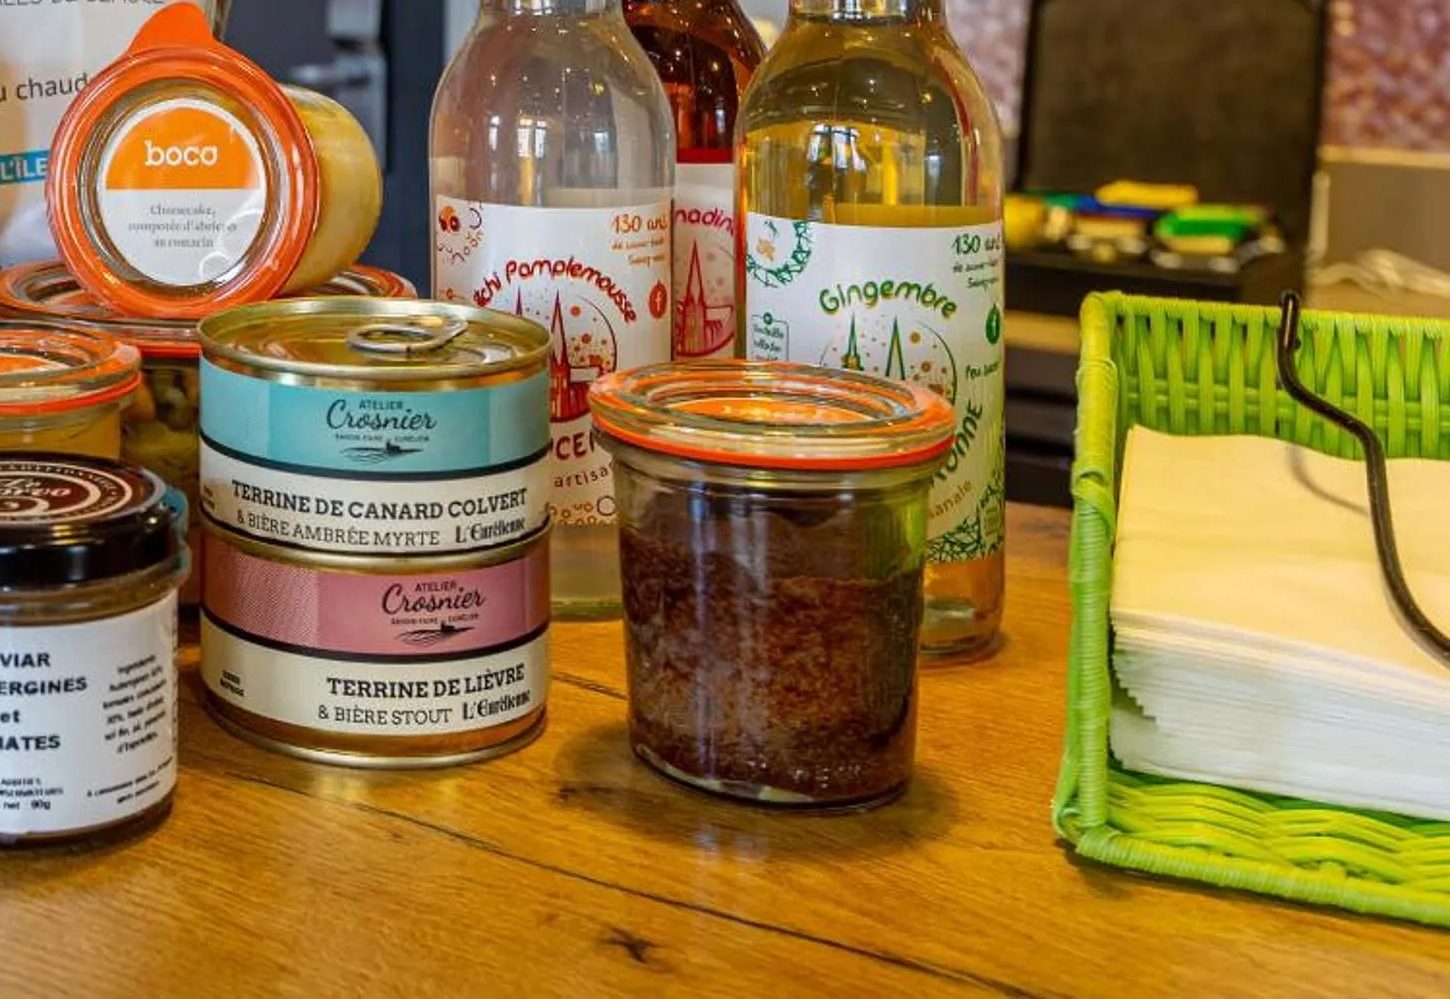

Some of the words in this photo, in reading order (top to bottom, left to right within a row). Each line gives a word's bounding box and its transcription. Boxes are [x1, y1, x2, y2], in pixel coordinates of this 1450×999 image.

[144, 138, 218, 166] boco
[612, 214, 641, 234] 130
[951, 233, 981, 254] 130
[506, 256, 637, 325] Pamplemousse
[818, 278, 959, 318] Gingembre
[326, 398, 437, 431] Crosnier
[359, 399, 403, 410] ATELIER
[232, 480, 311, 514] TERRINE
[314, 496, 344, 518] DE
[348, 500, 442, 523] CANARD
[448, 487, 528, 518] COLVERT
[237, 510, 247, 525] &
[248, 511, 290, 538] BIÈRE
[291, 522, 370, 547] AMBRÉE
[374, 530, 440, 547] MYRTE
[382, 582, 486, 616] Crosnier
[414, 580, 458, 592] ATELIER
[327, 677, 429, 700] TERRINE
[433, 679, 461, 697] DE
[465, 663, 525, 695] LIÈVRE
[0, 710, 21, 723] et
[318, 705, 329, 720] &
[334, 703, 388, 726] BIÈRE
[392, 708, 453, 725] STOUT
